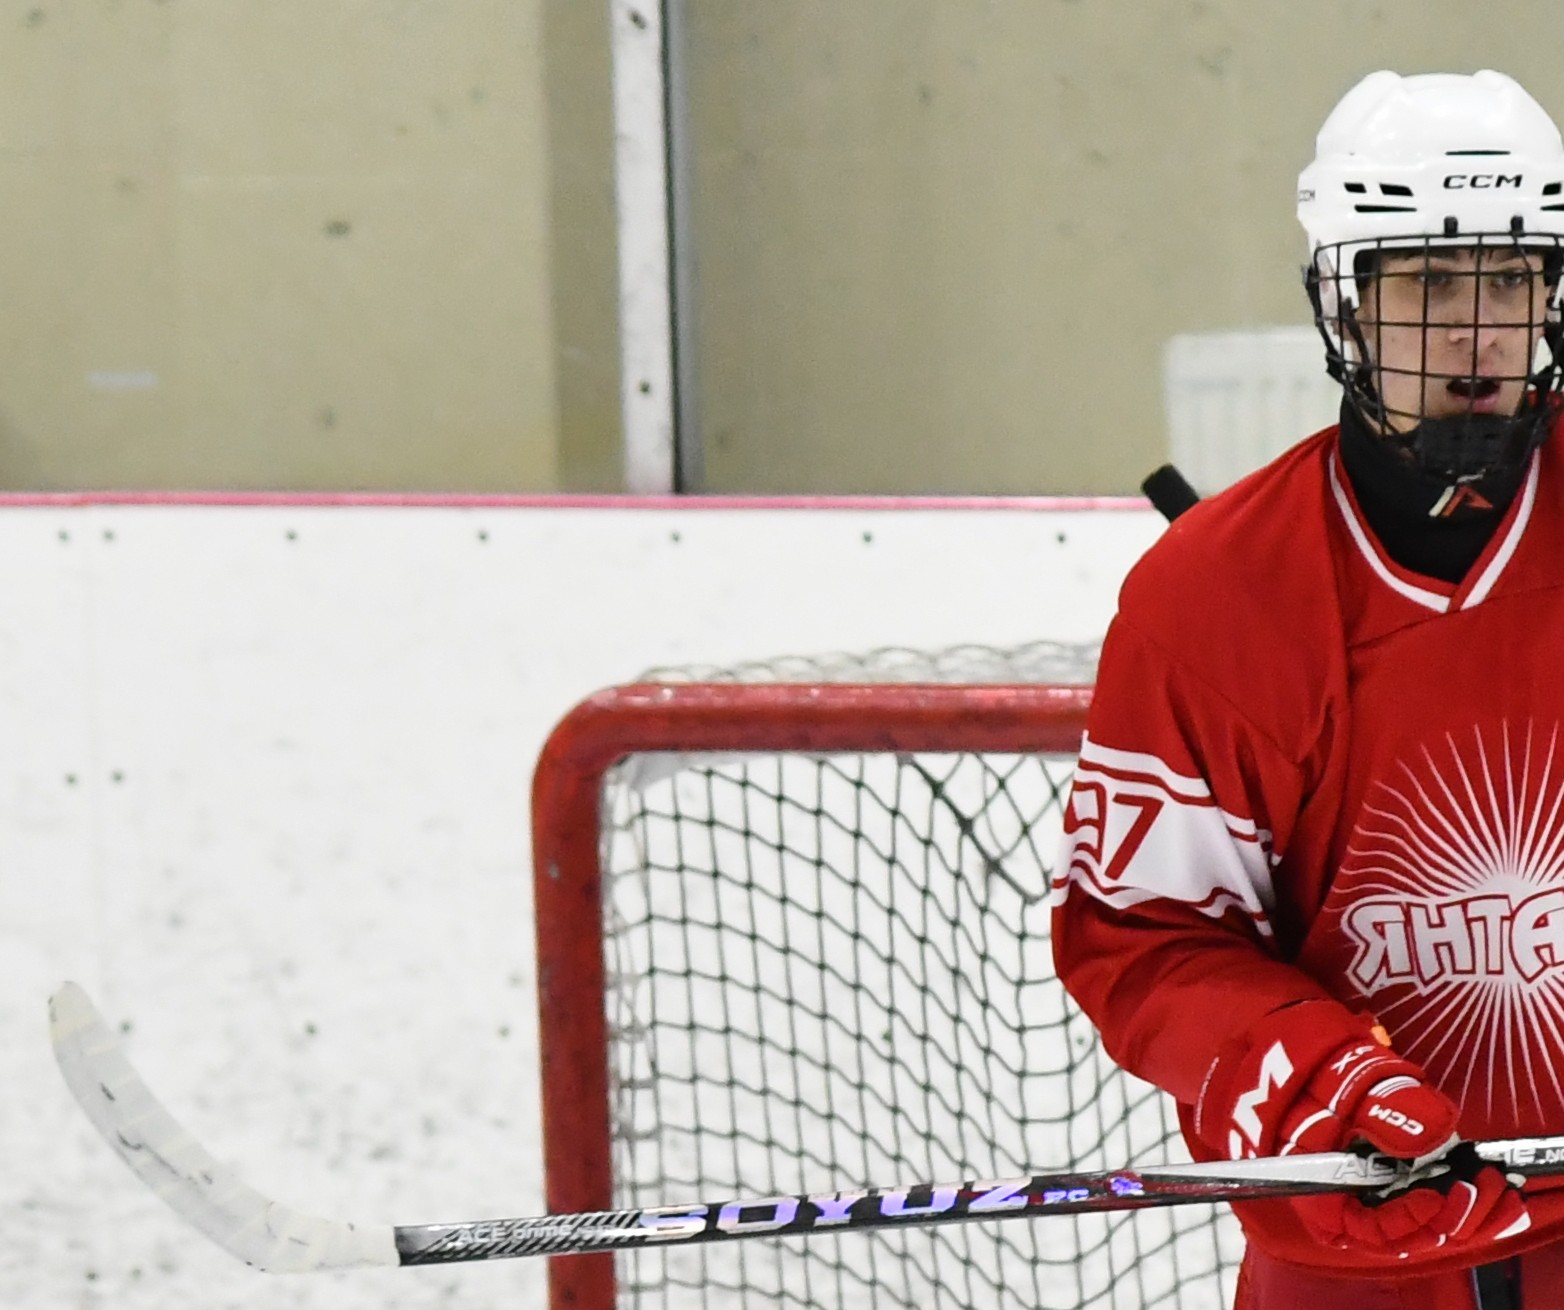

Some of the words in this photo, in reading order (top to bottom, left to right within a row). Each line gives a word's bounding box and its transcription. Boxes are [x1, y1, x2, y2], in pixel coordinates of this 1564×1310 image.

[1442, 174, 1523, 190] CCM
[1367, 1103, 1425, 1136] CCM
[639, 1176, 1033, 1242] SOYUZ
